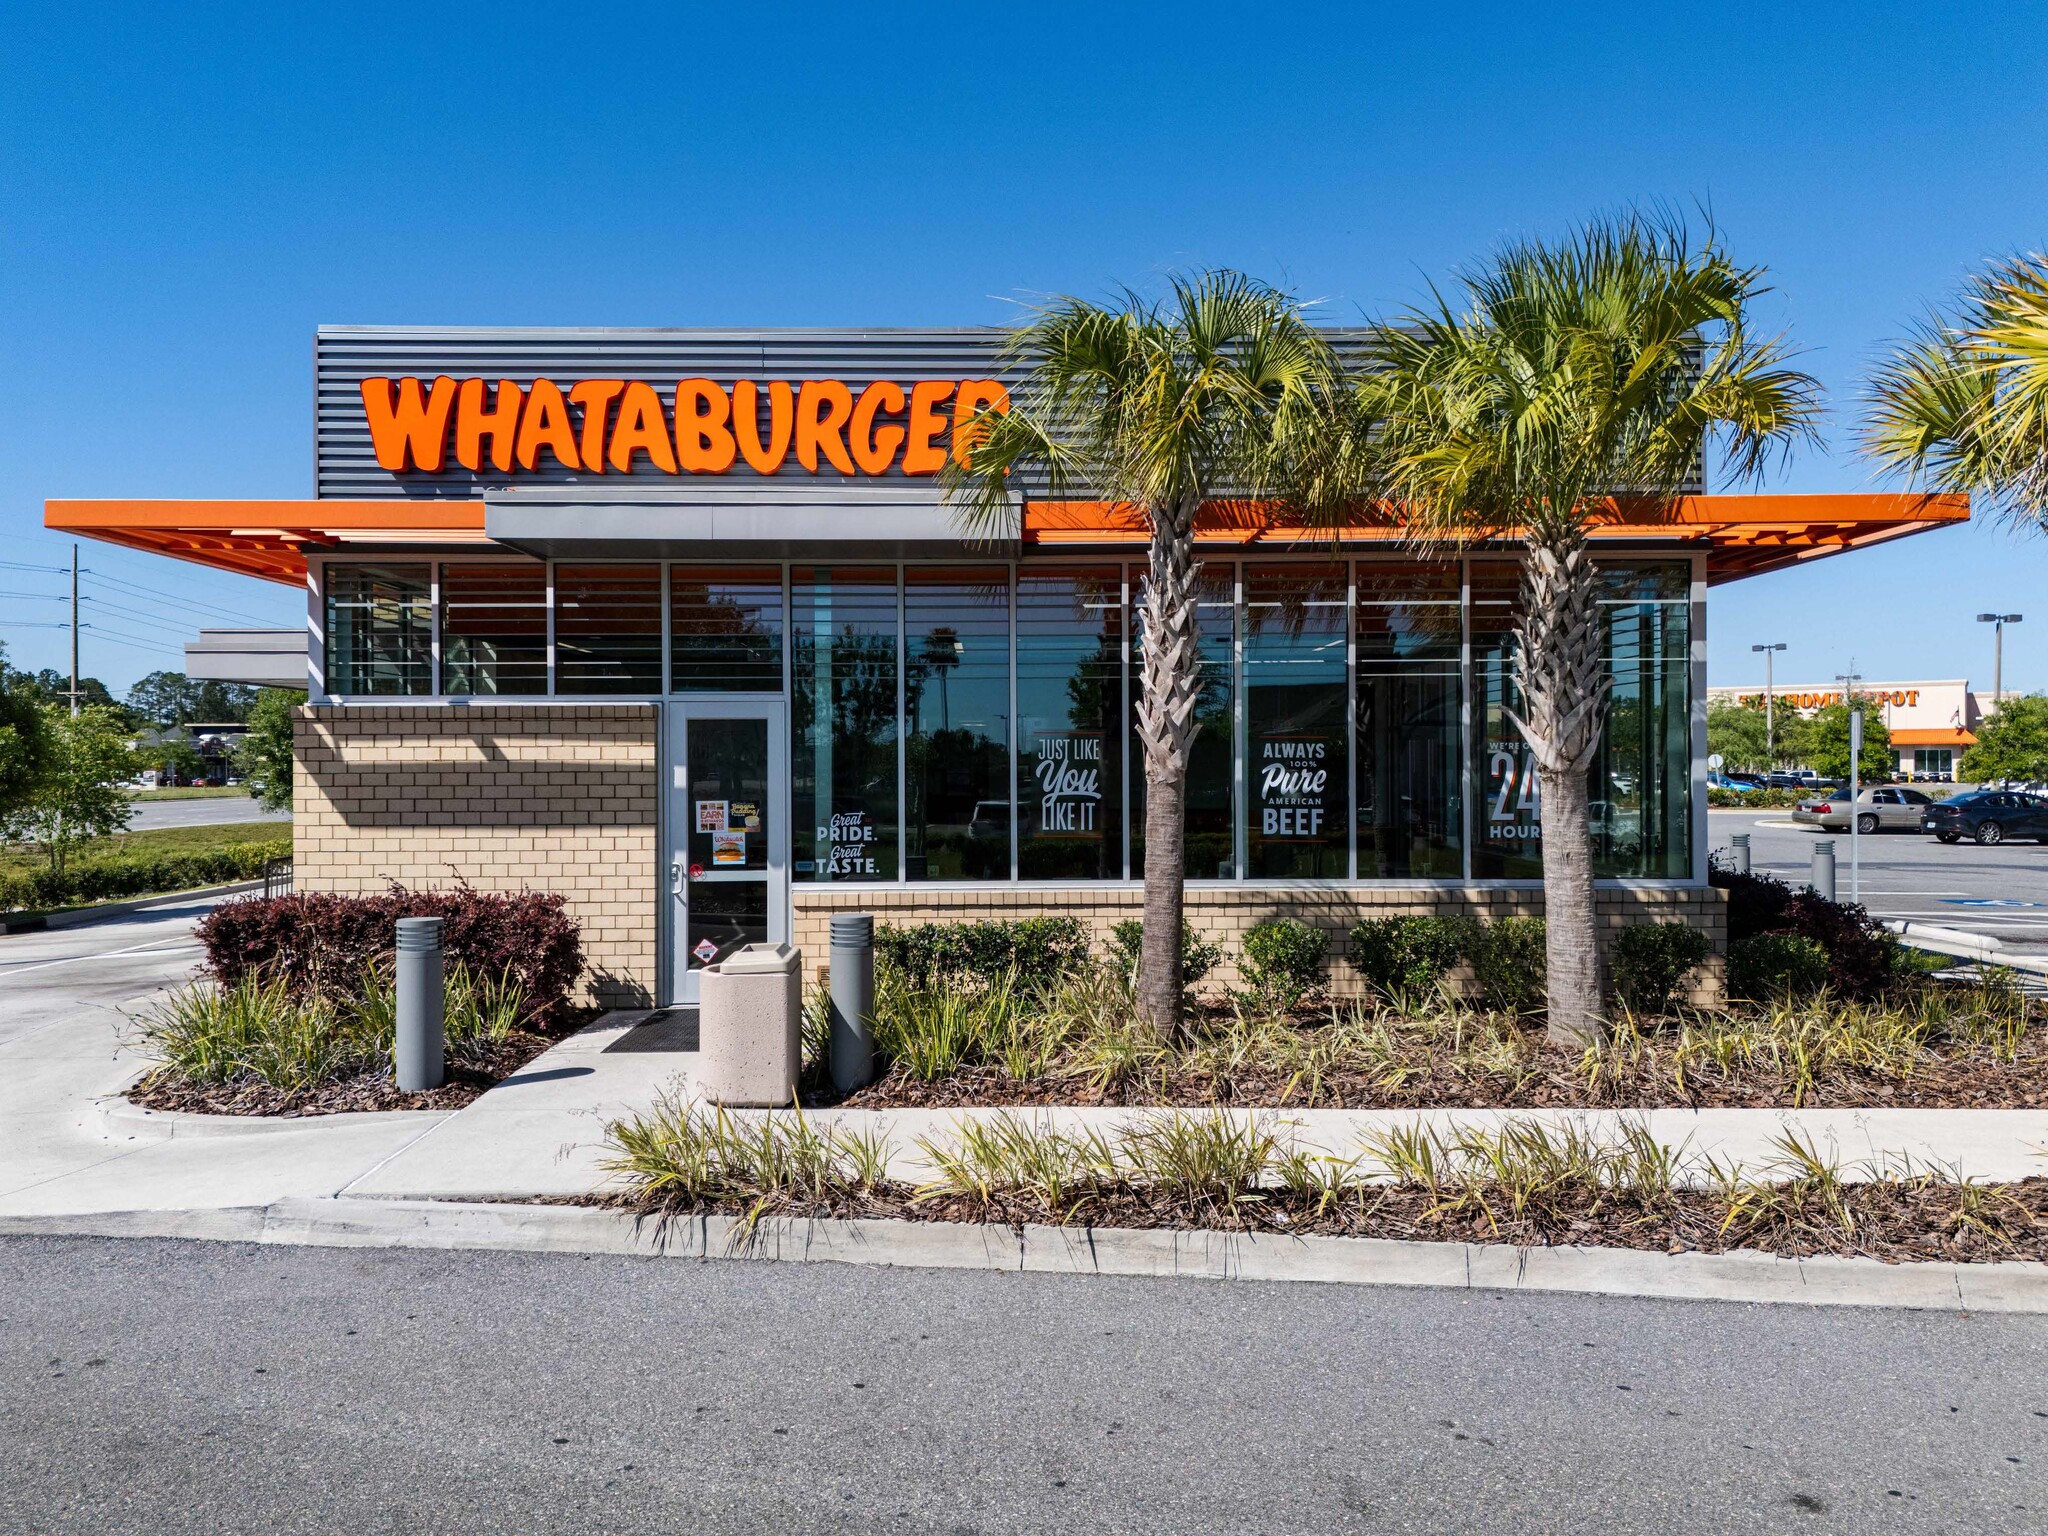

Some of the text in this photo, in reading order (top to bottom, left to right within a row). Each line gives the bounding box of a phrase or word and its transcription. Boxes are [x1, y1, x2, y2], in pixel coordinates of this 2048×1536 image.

[361, 376, 1011, 477] WHATABURGER
[1038, 739, 1100, 760] JUST LIKE
[1263, 743, 1325, 758] ALWAYS
[1489, 742, 1520, 750] WE'RE
[1035, 758, 1102, 807] You
[1261, 762, 1327, 800] Pure
[1491, 751, 1541, 821] 24
[1268, 797, 1322, 805] AMERICAN
[701, 810, 725, 819] EARN
[830, 811, 866, 828] Great
[1042, 802, 1096, 831] LIKE IT
[1263, 808, 1324, 835] BEEF
[817, 826, 878, 841] PRIDE.
[1490, 825, 1543, 839] HOUR
[830, 843, 866, 860] Great
[815, 858, 880, 873] TASTE.
